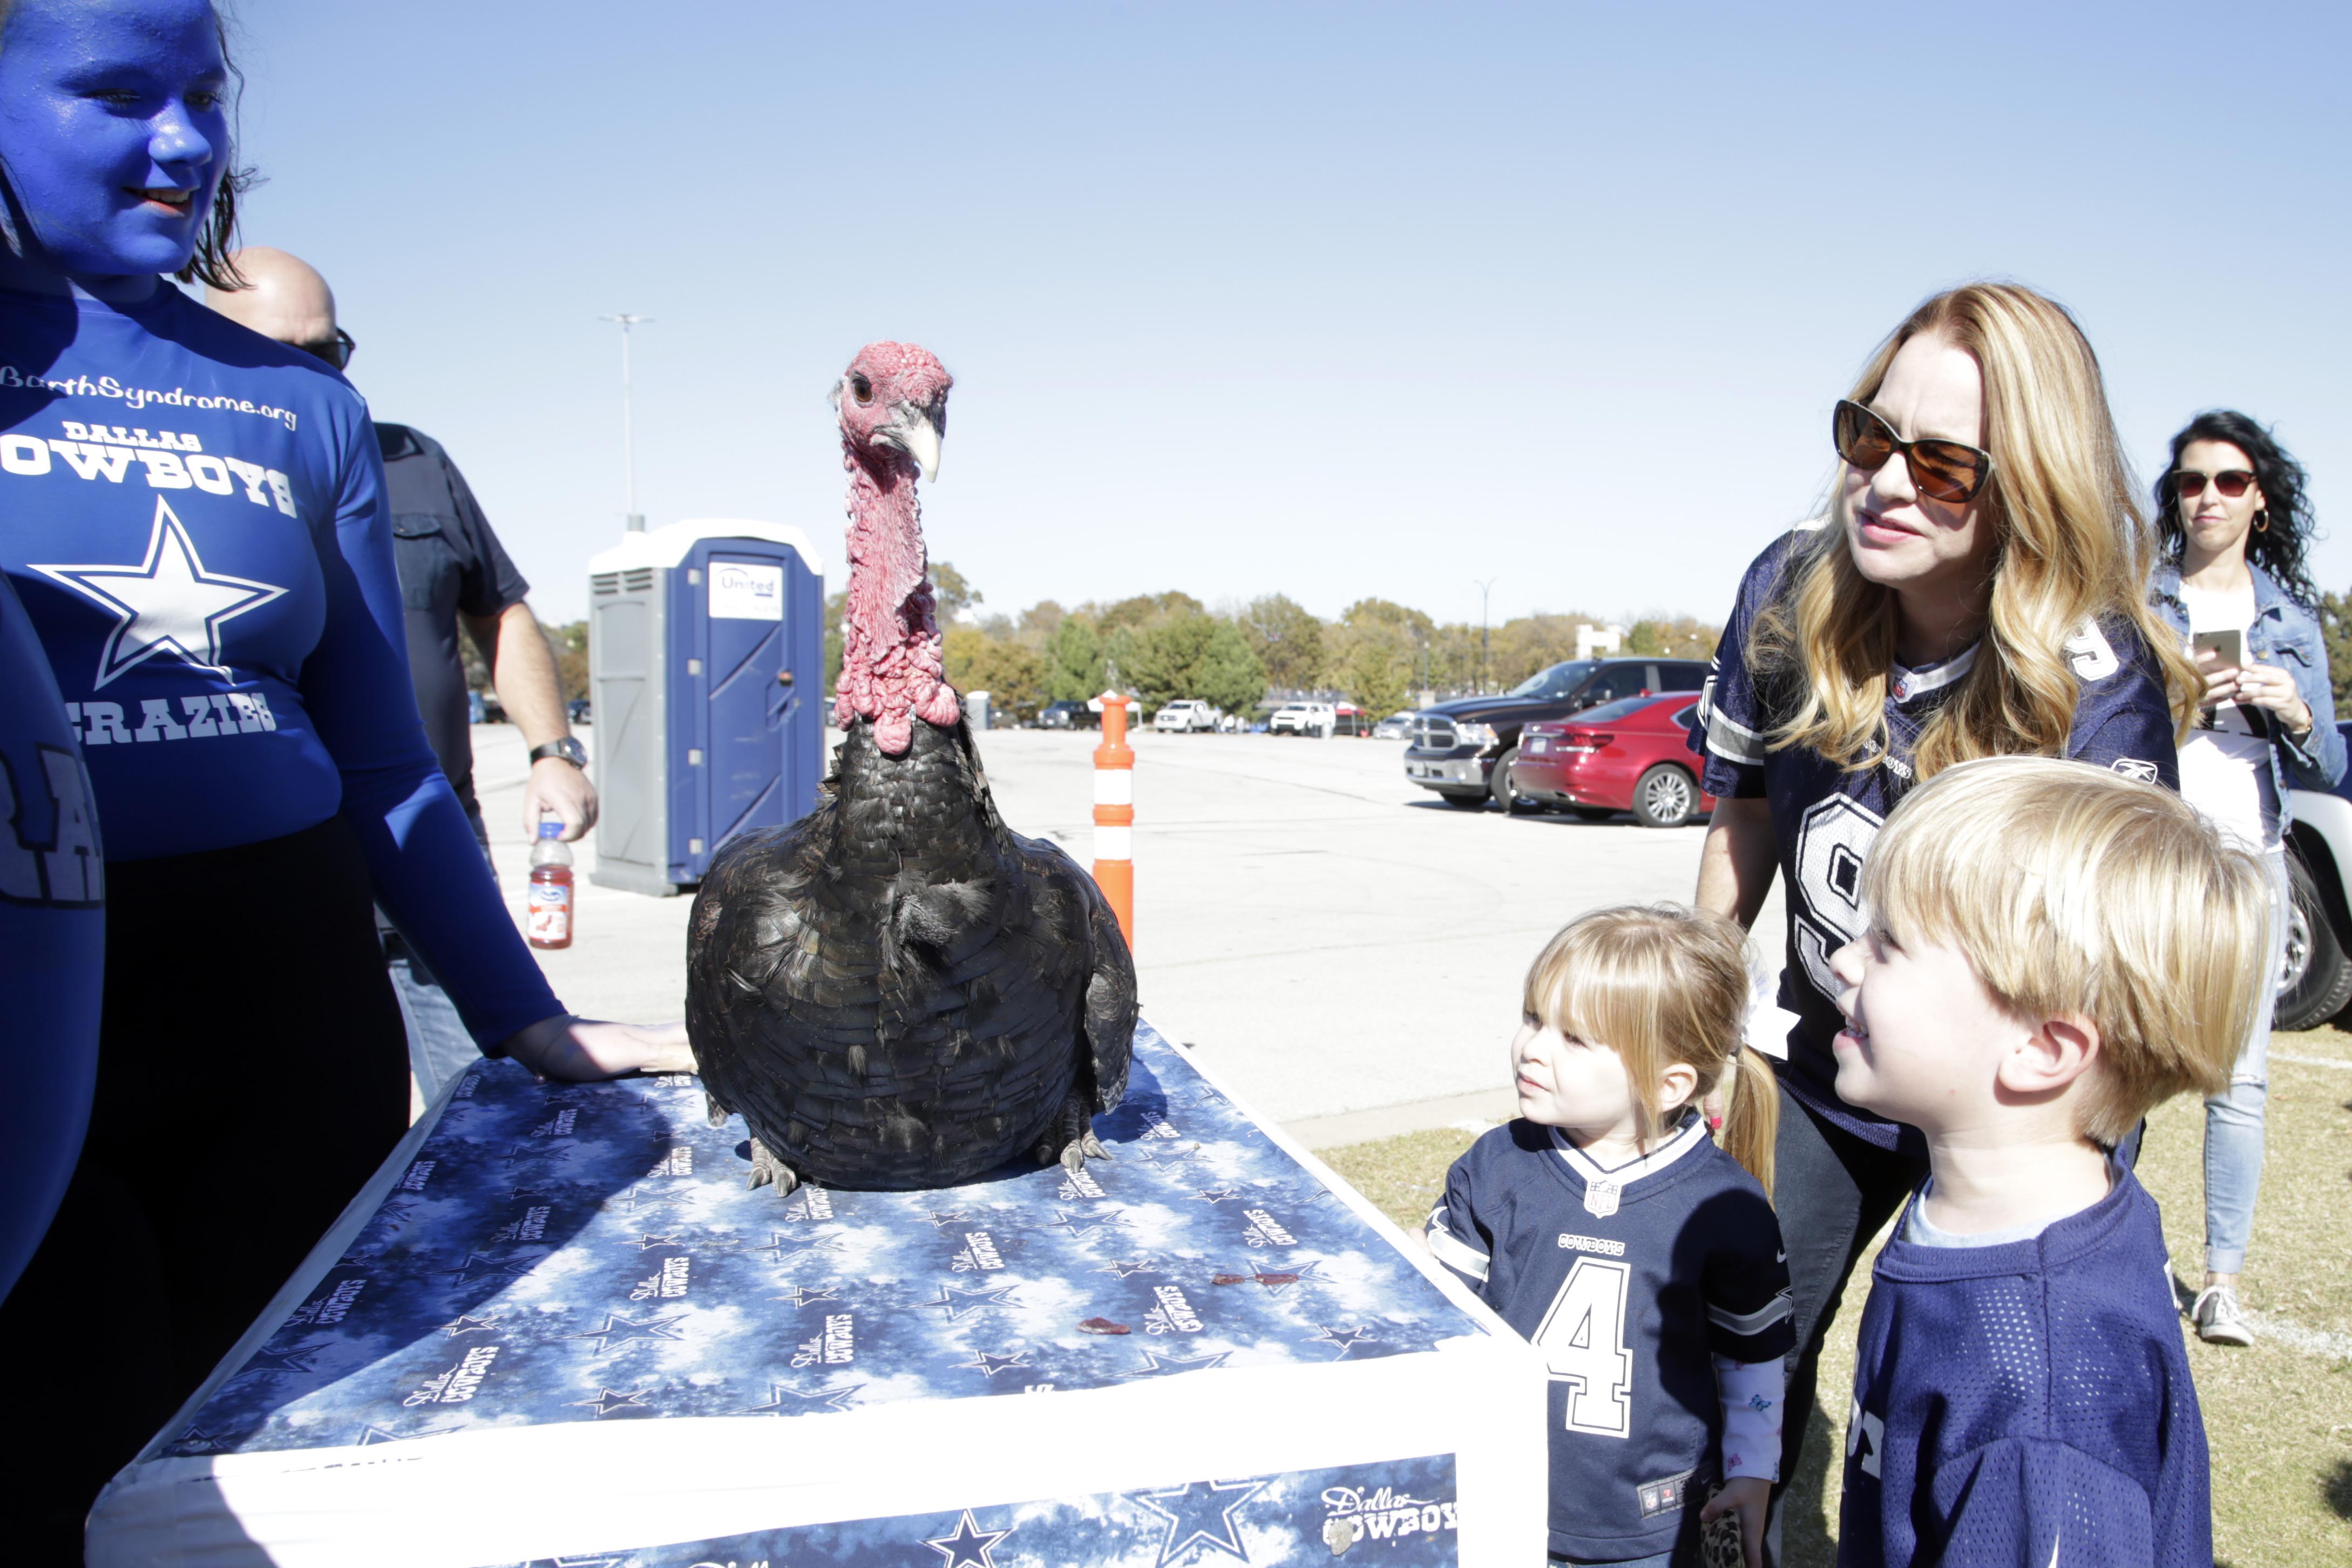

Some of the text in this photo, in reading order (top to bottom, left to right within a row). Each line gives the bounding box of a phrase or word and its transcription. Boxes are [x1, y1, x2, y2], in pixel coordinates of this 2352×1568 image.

[62, 421, 202, 452] DALLAS
[722, 577, 774, 592] Unted
[1590, 1192, 1613, 1210] NFL
[1558, 1233, 1625, 1257] COWBOYS
[1531, 1256, 1632, 1438] 4
[1321, 1486, 1440, 1517] Dallas
